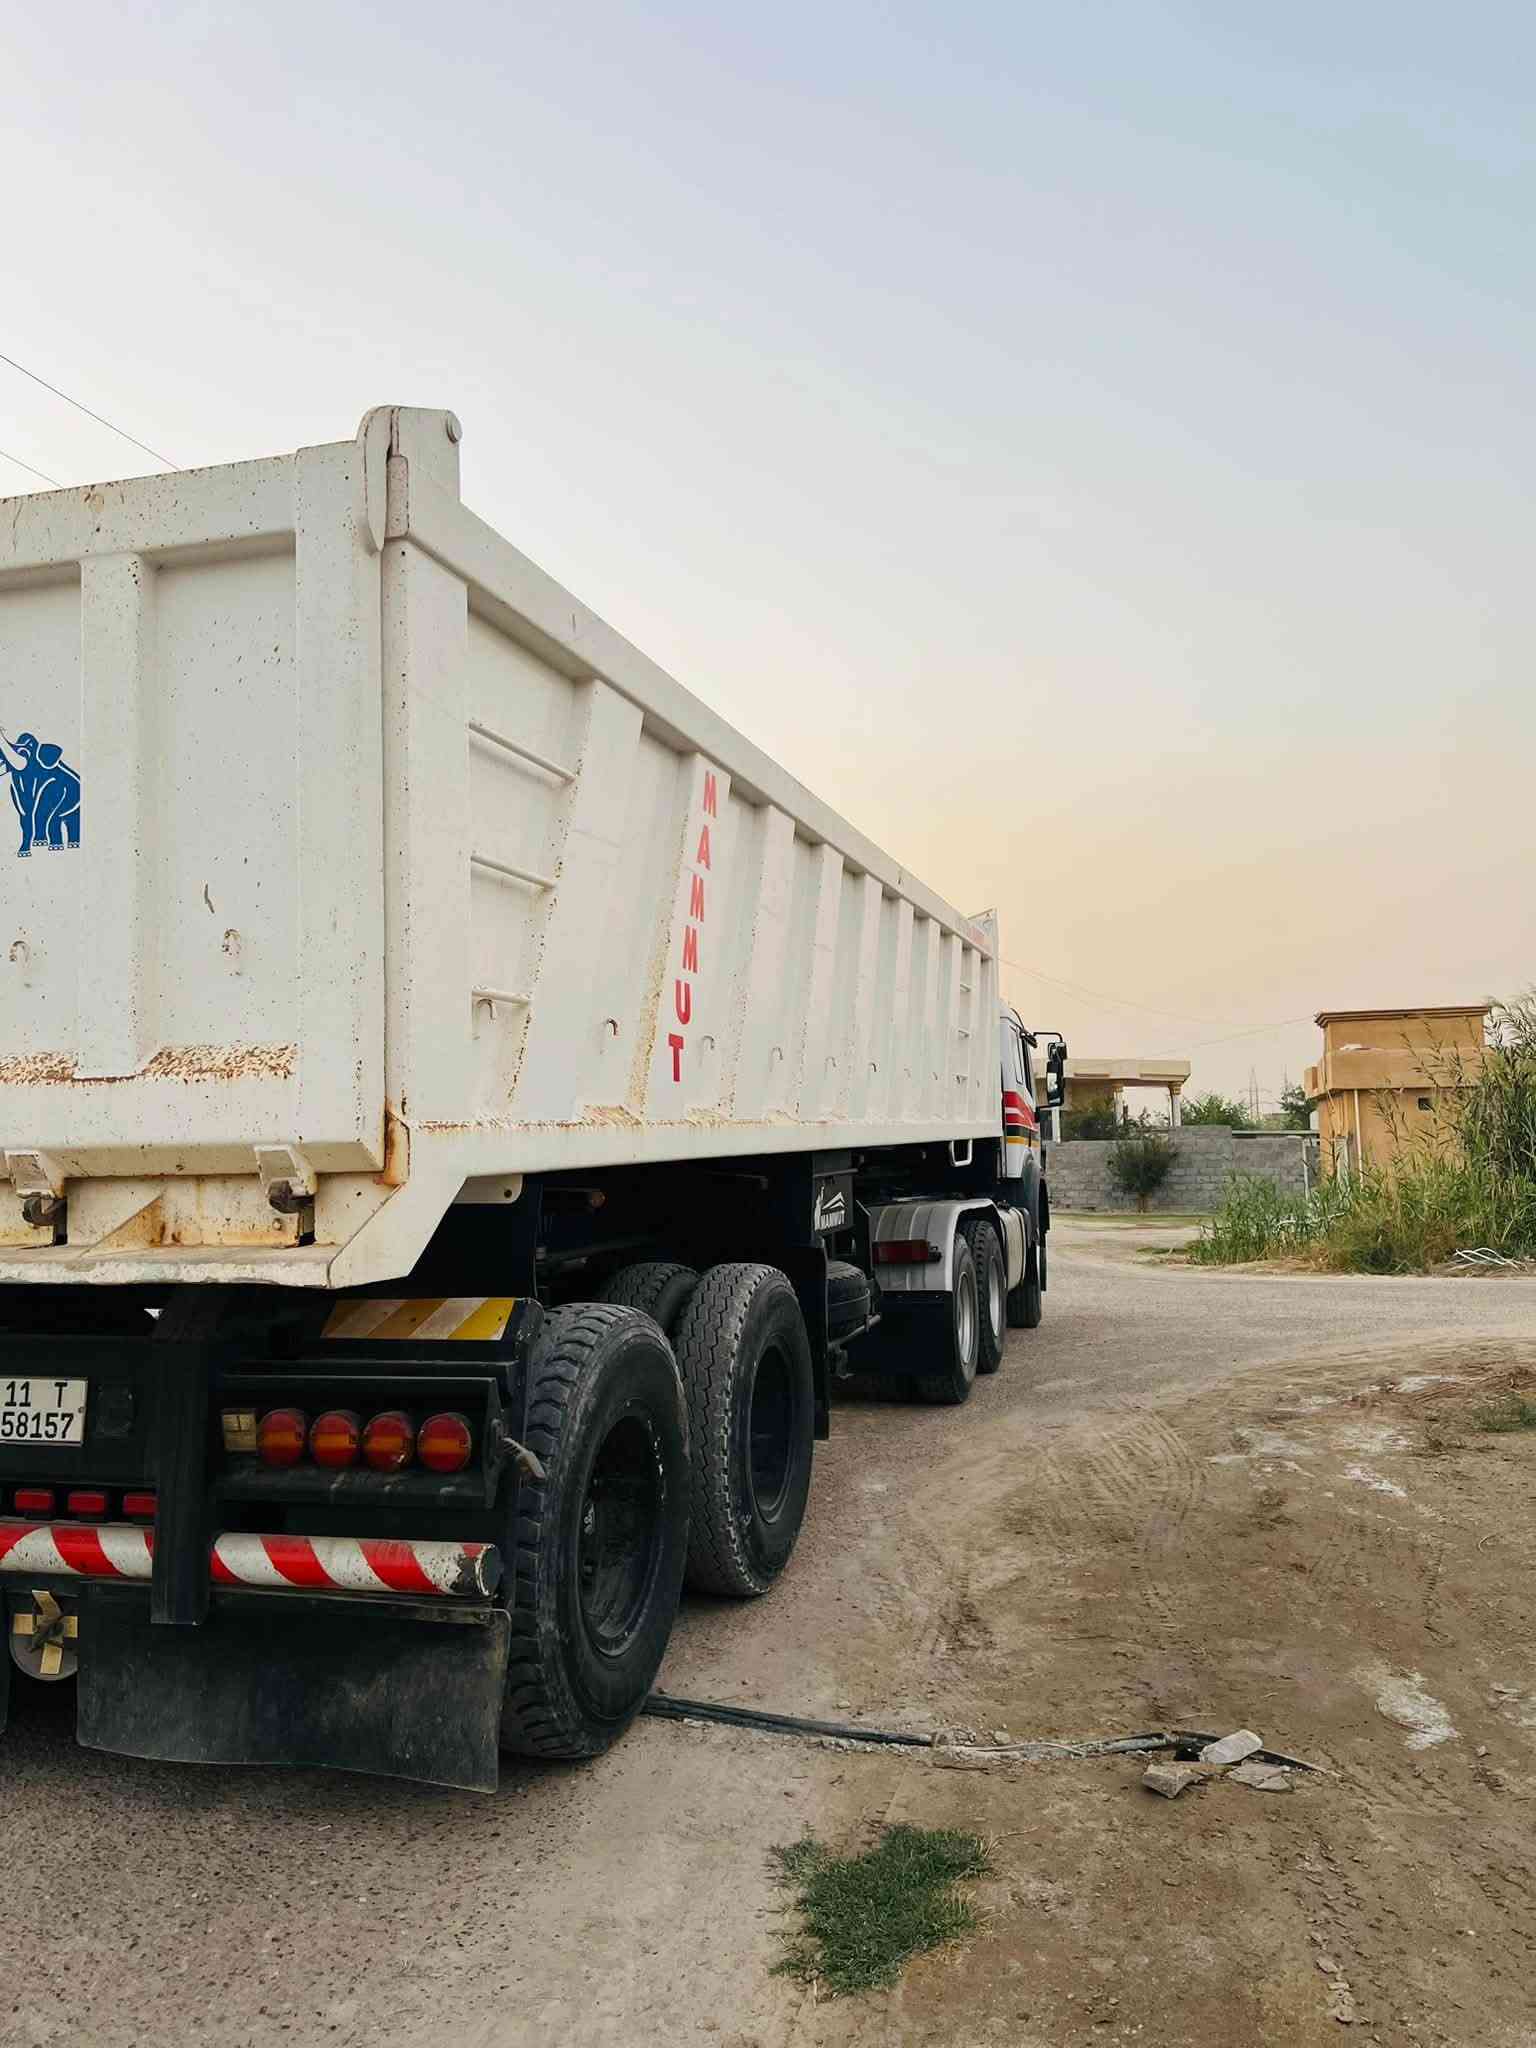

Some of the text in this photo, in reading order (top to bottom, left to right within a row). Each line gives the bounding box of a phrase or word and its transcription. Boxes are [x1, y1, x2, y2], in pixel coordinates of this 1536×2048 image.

[668, 770, 717, 1082] MAMMUT
[4, 1380, 68, 1408] 11 T
[1, 1411, 74, 1439] 58157
